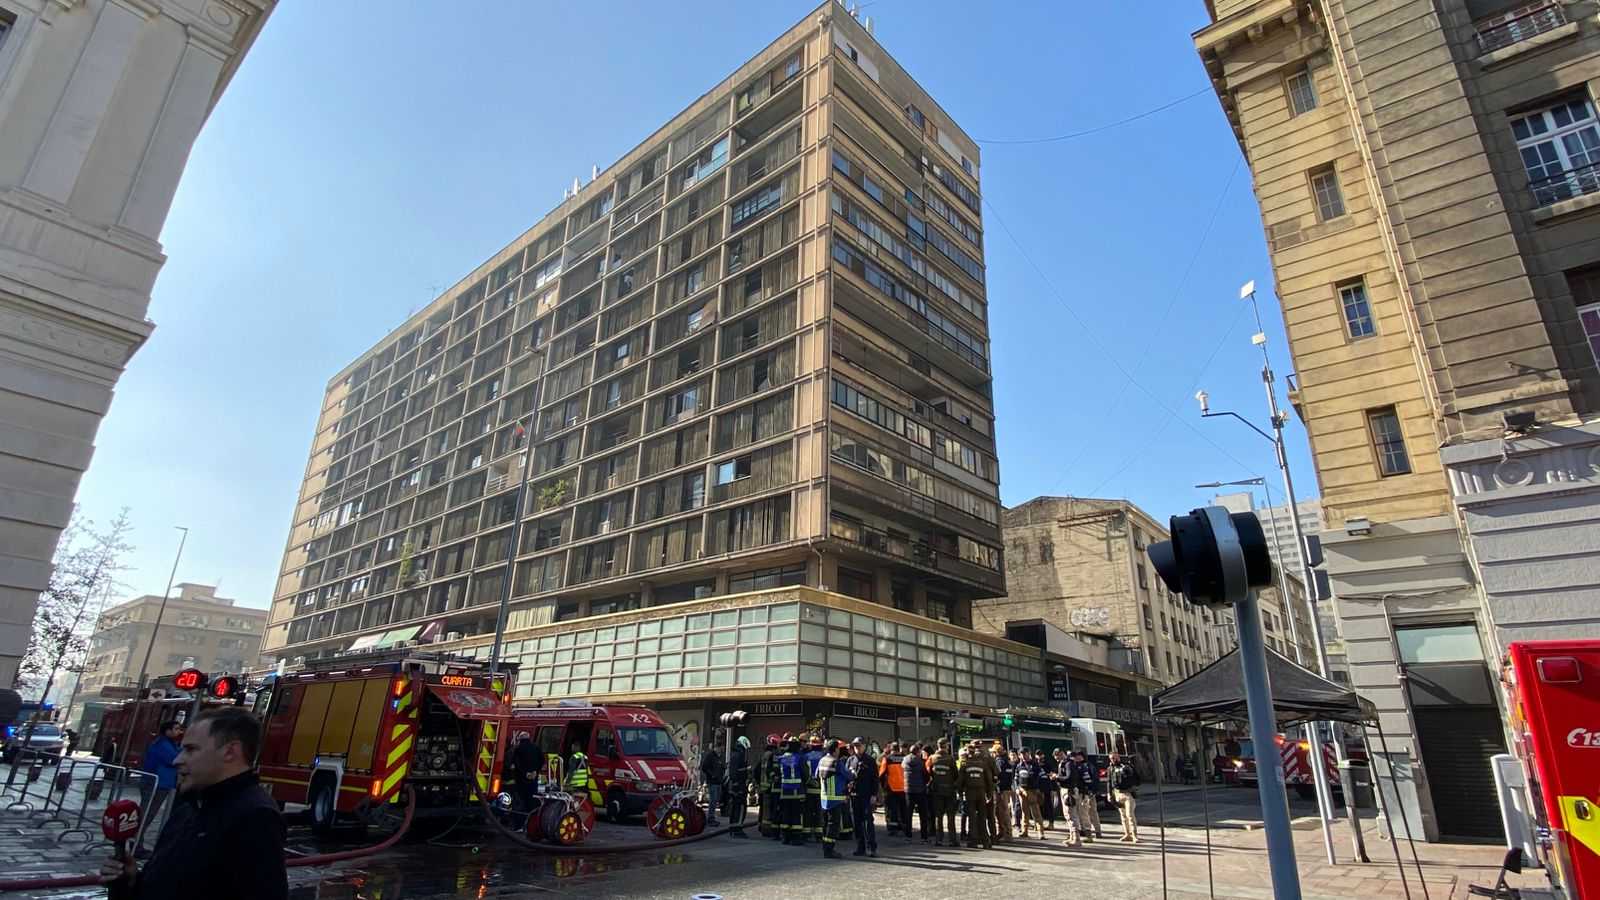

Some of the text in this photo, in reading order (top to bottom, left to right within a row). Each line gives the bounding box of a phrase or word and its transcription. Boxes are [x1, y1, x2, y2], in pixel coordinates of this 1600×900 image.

[177, 672, 198, 687] 20
[441, 675, 473, 687] CUARTA
[754, 703, 786, 713] TRICOT
[853, 706, 880, 718] TRICOT
